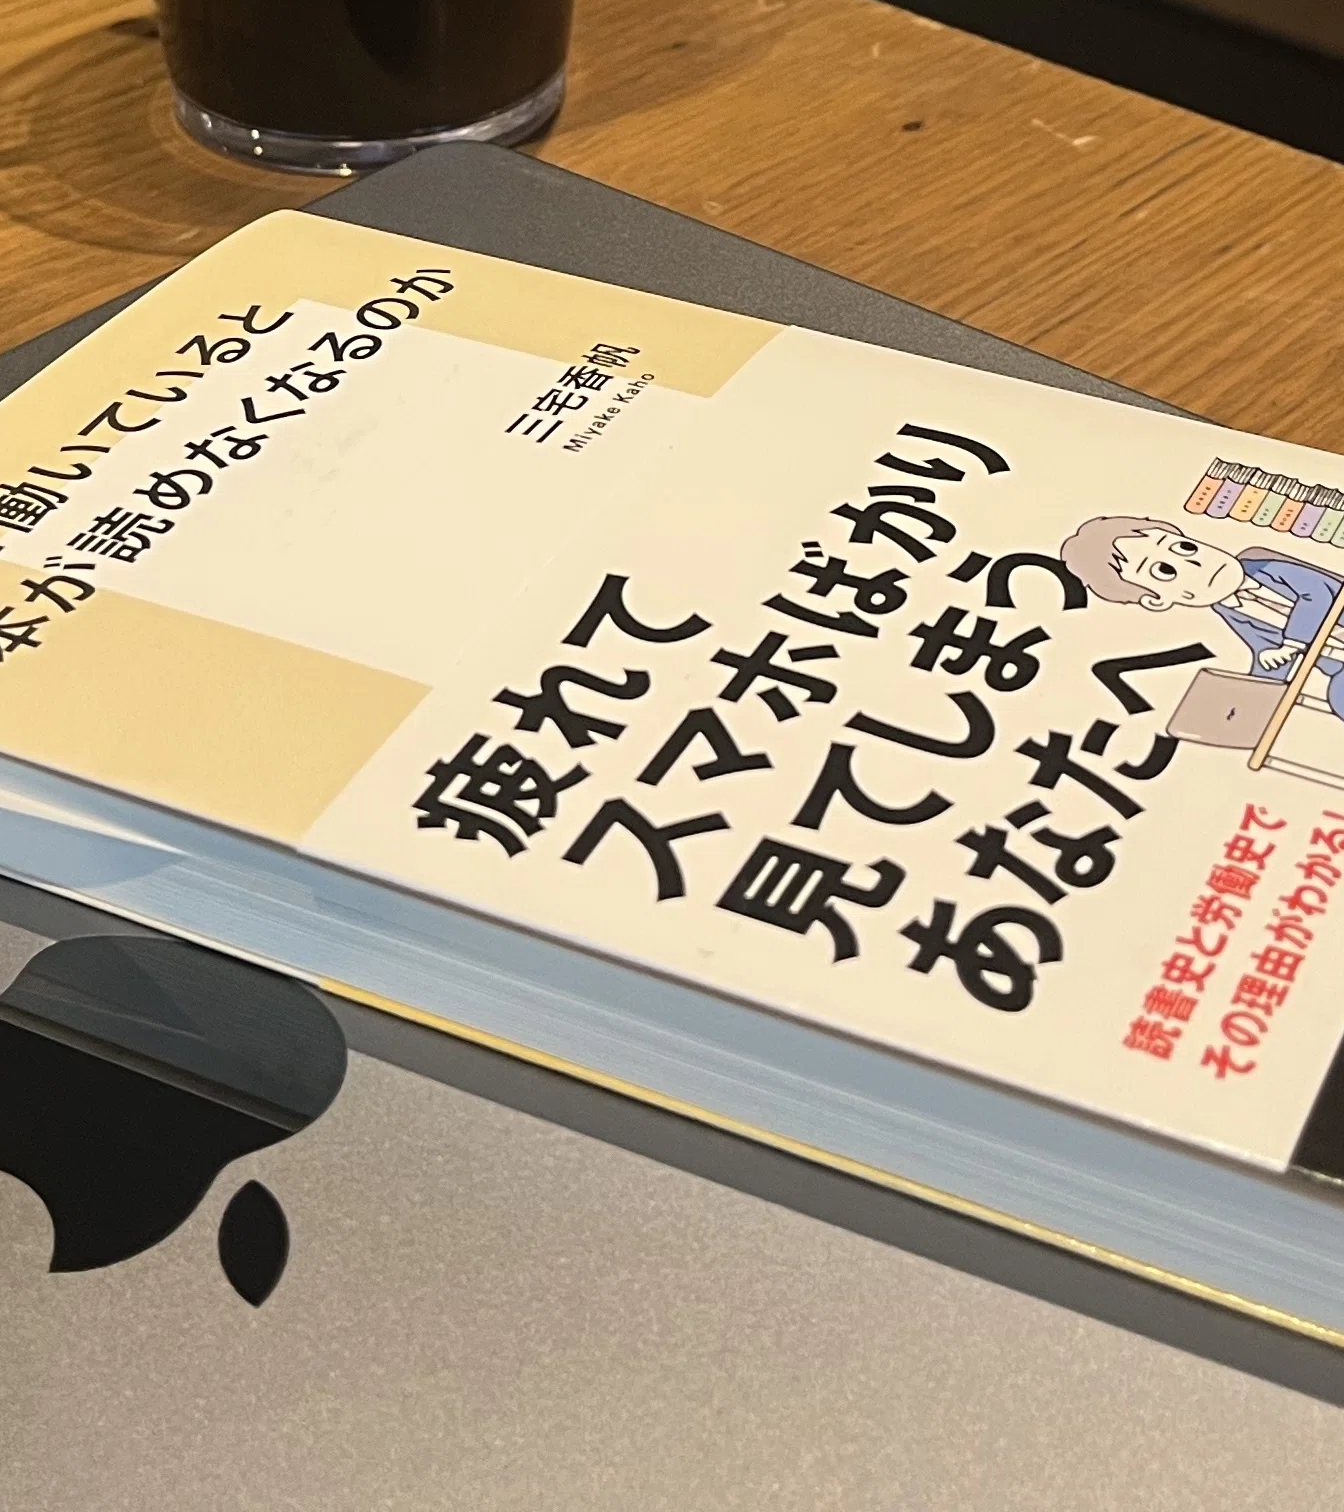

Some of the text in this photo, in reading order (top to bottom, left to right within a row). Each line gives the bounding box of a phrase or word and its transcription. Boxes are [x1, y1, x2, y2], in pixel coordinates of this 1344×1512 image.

[504, 343, 641, 444] 三宅香帆
[562, 373, 655, 453] Miyake Kaho
[411, 573, 713, 859] 疲れて
[562, 422, 1011, 903] スマホばかり
[716, 551, 1089, 964] 見てしまう
[899, 640, 1216, 1014] あなたへ
[1122, 802, 1288, 1061] 読書史と労働史で
